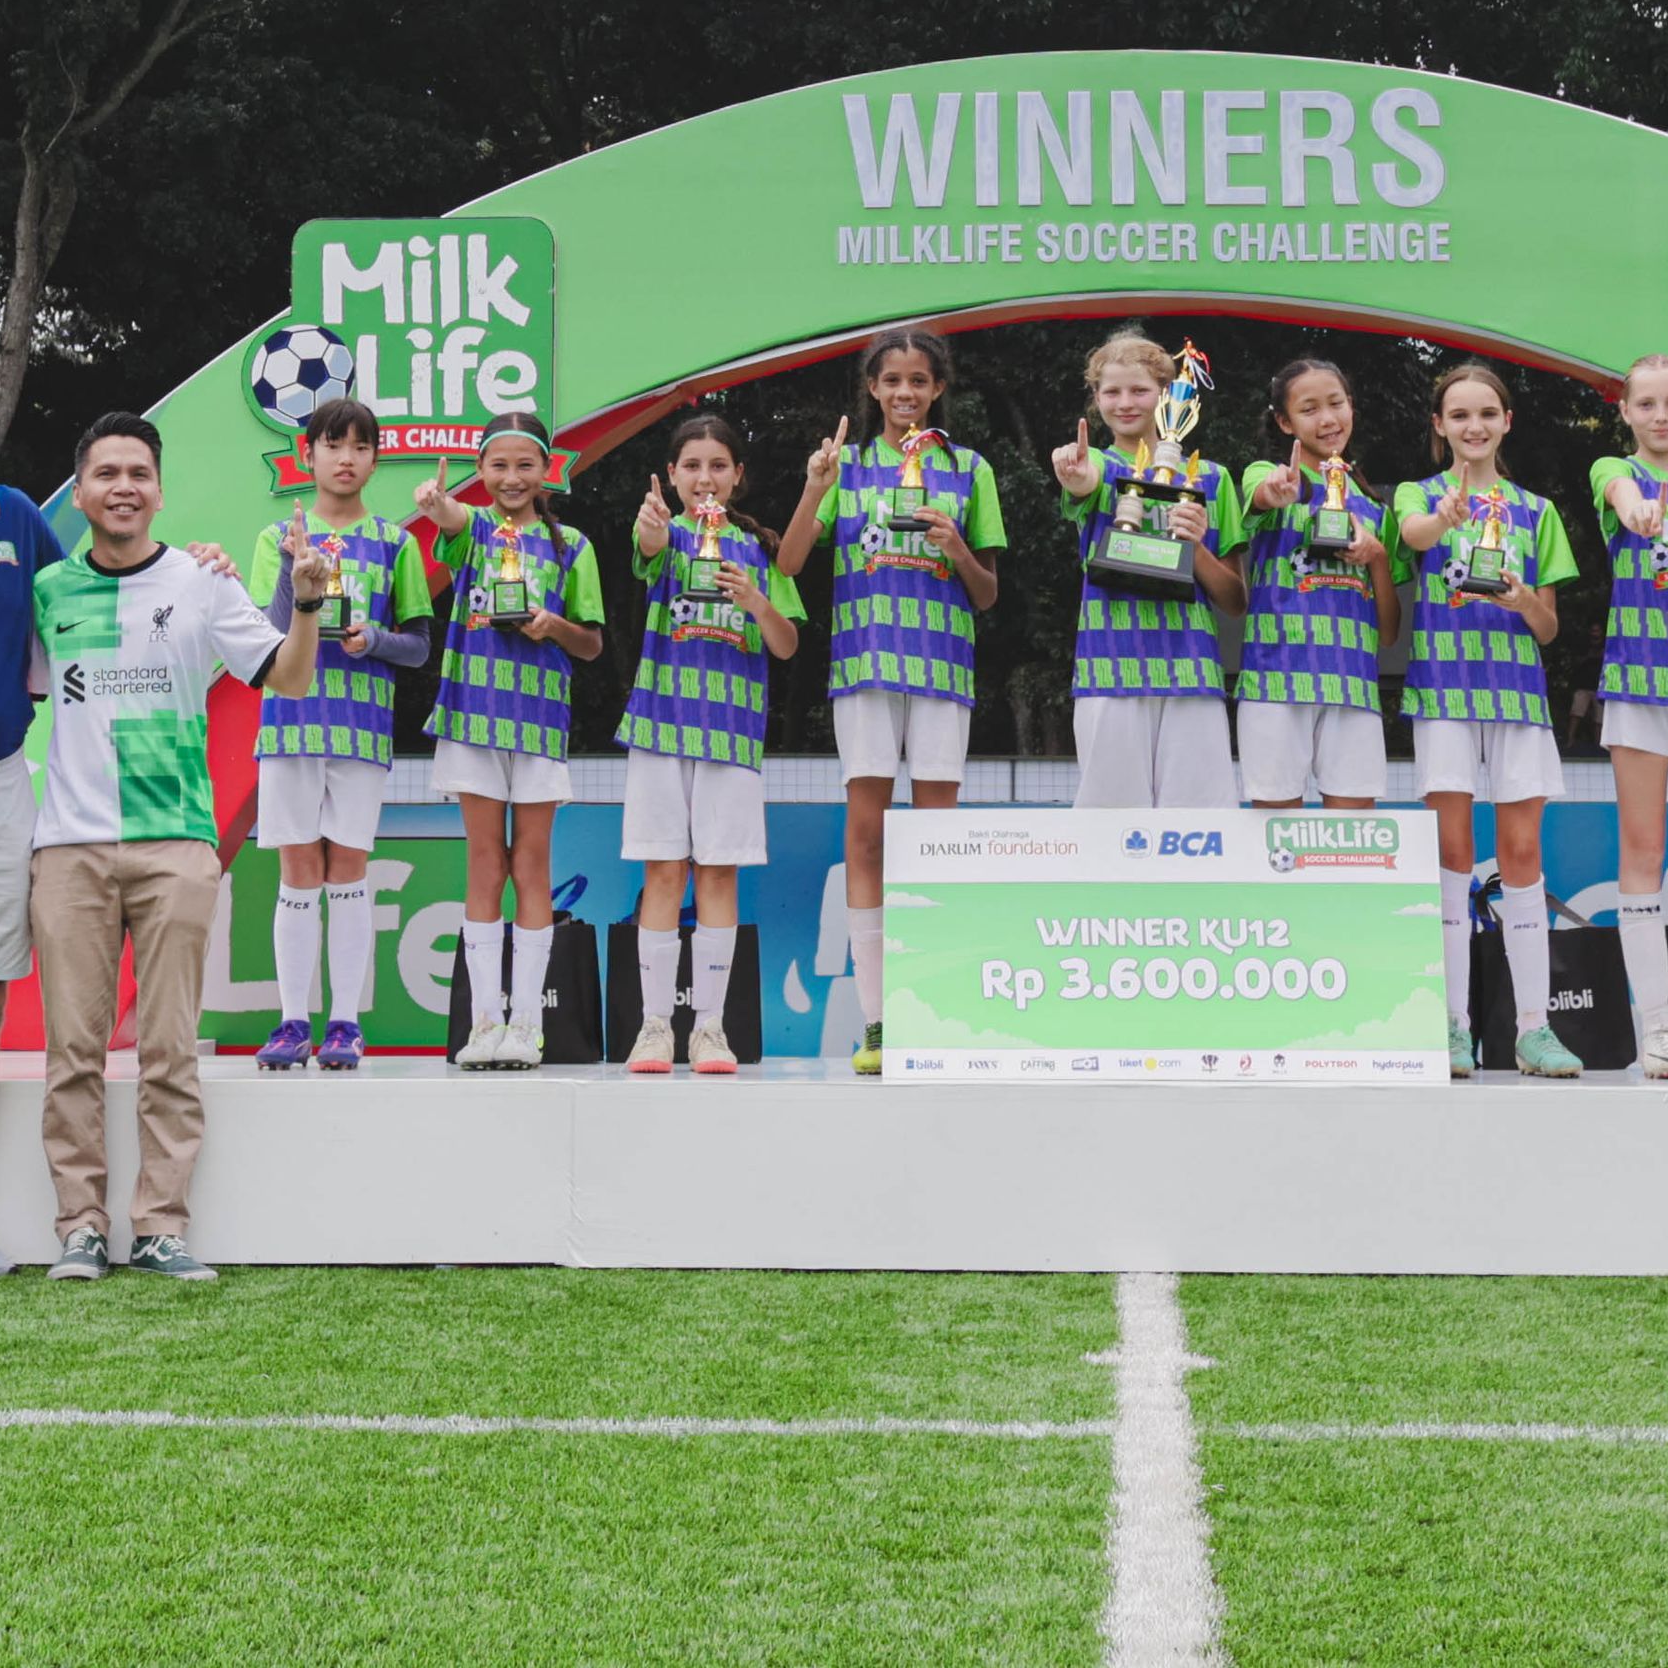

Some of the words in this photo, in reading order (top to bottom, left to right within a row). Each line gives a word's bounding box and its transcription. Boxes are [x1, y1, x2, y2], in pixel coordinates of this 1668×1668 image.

[842, 87, 1446, 209] WINNERS
[838, 224, 1023, 264] MILKLIFE
[1036, 223, 1198, 263] SOCCER
[1213, 222, 1451, 263] CHALLENGE
[322, 233, 531, 328] Milk
[355, 327, 538, 418] Life
[92, 666, 168, 682] standard
[92, 681, 172, 696] chartered
[920, 842, 982, 856] DJARUM
[987, 839, 1078, 856] foundation
[1158, 830, 1223, 857] BCA
[1273, 820, 1394, 849] MilkLife
[1303, 854, 1336, 864] SOCCER
[1338, 855, 1386, 865] CHALLENGE
[1036, 917, 1190, 947] WINNER
[1199, 917, 1292, 955] KU12
[982, 959, 1045, 1011] Rp
[1059, 956, 1348, 1000] 3.600.000
